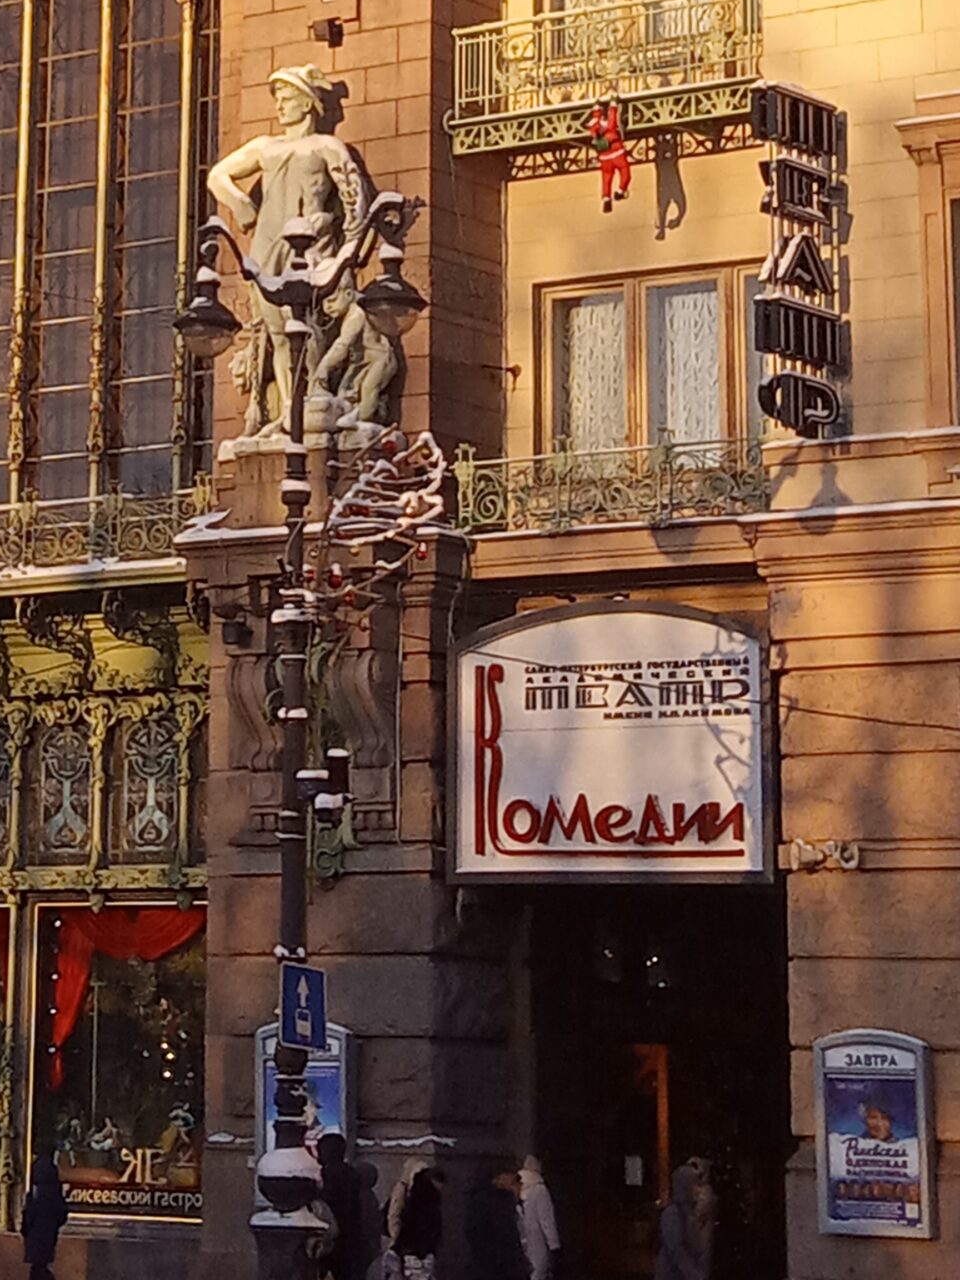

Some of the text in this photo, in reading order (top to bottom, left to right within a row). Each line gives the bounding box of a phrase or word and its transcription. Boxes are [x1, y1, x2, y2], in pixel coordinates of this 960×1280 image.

[647, 656, 749, 670] ГОСУДАРСТВЕННЫЙ
[525, 668, 750, 684] АКАДЕМИЧЕСКИЙ
[844, 1053, 898, 1066] ЗАВТРА
[154, 1192, 203, 1212] гастро
